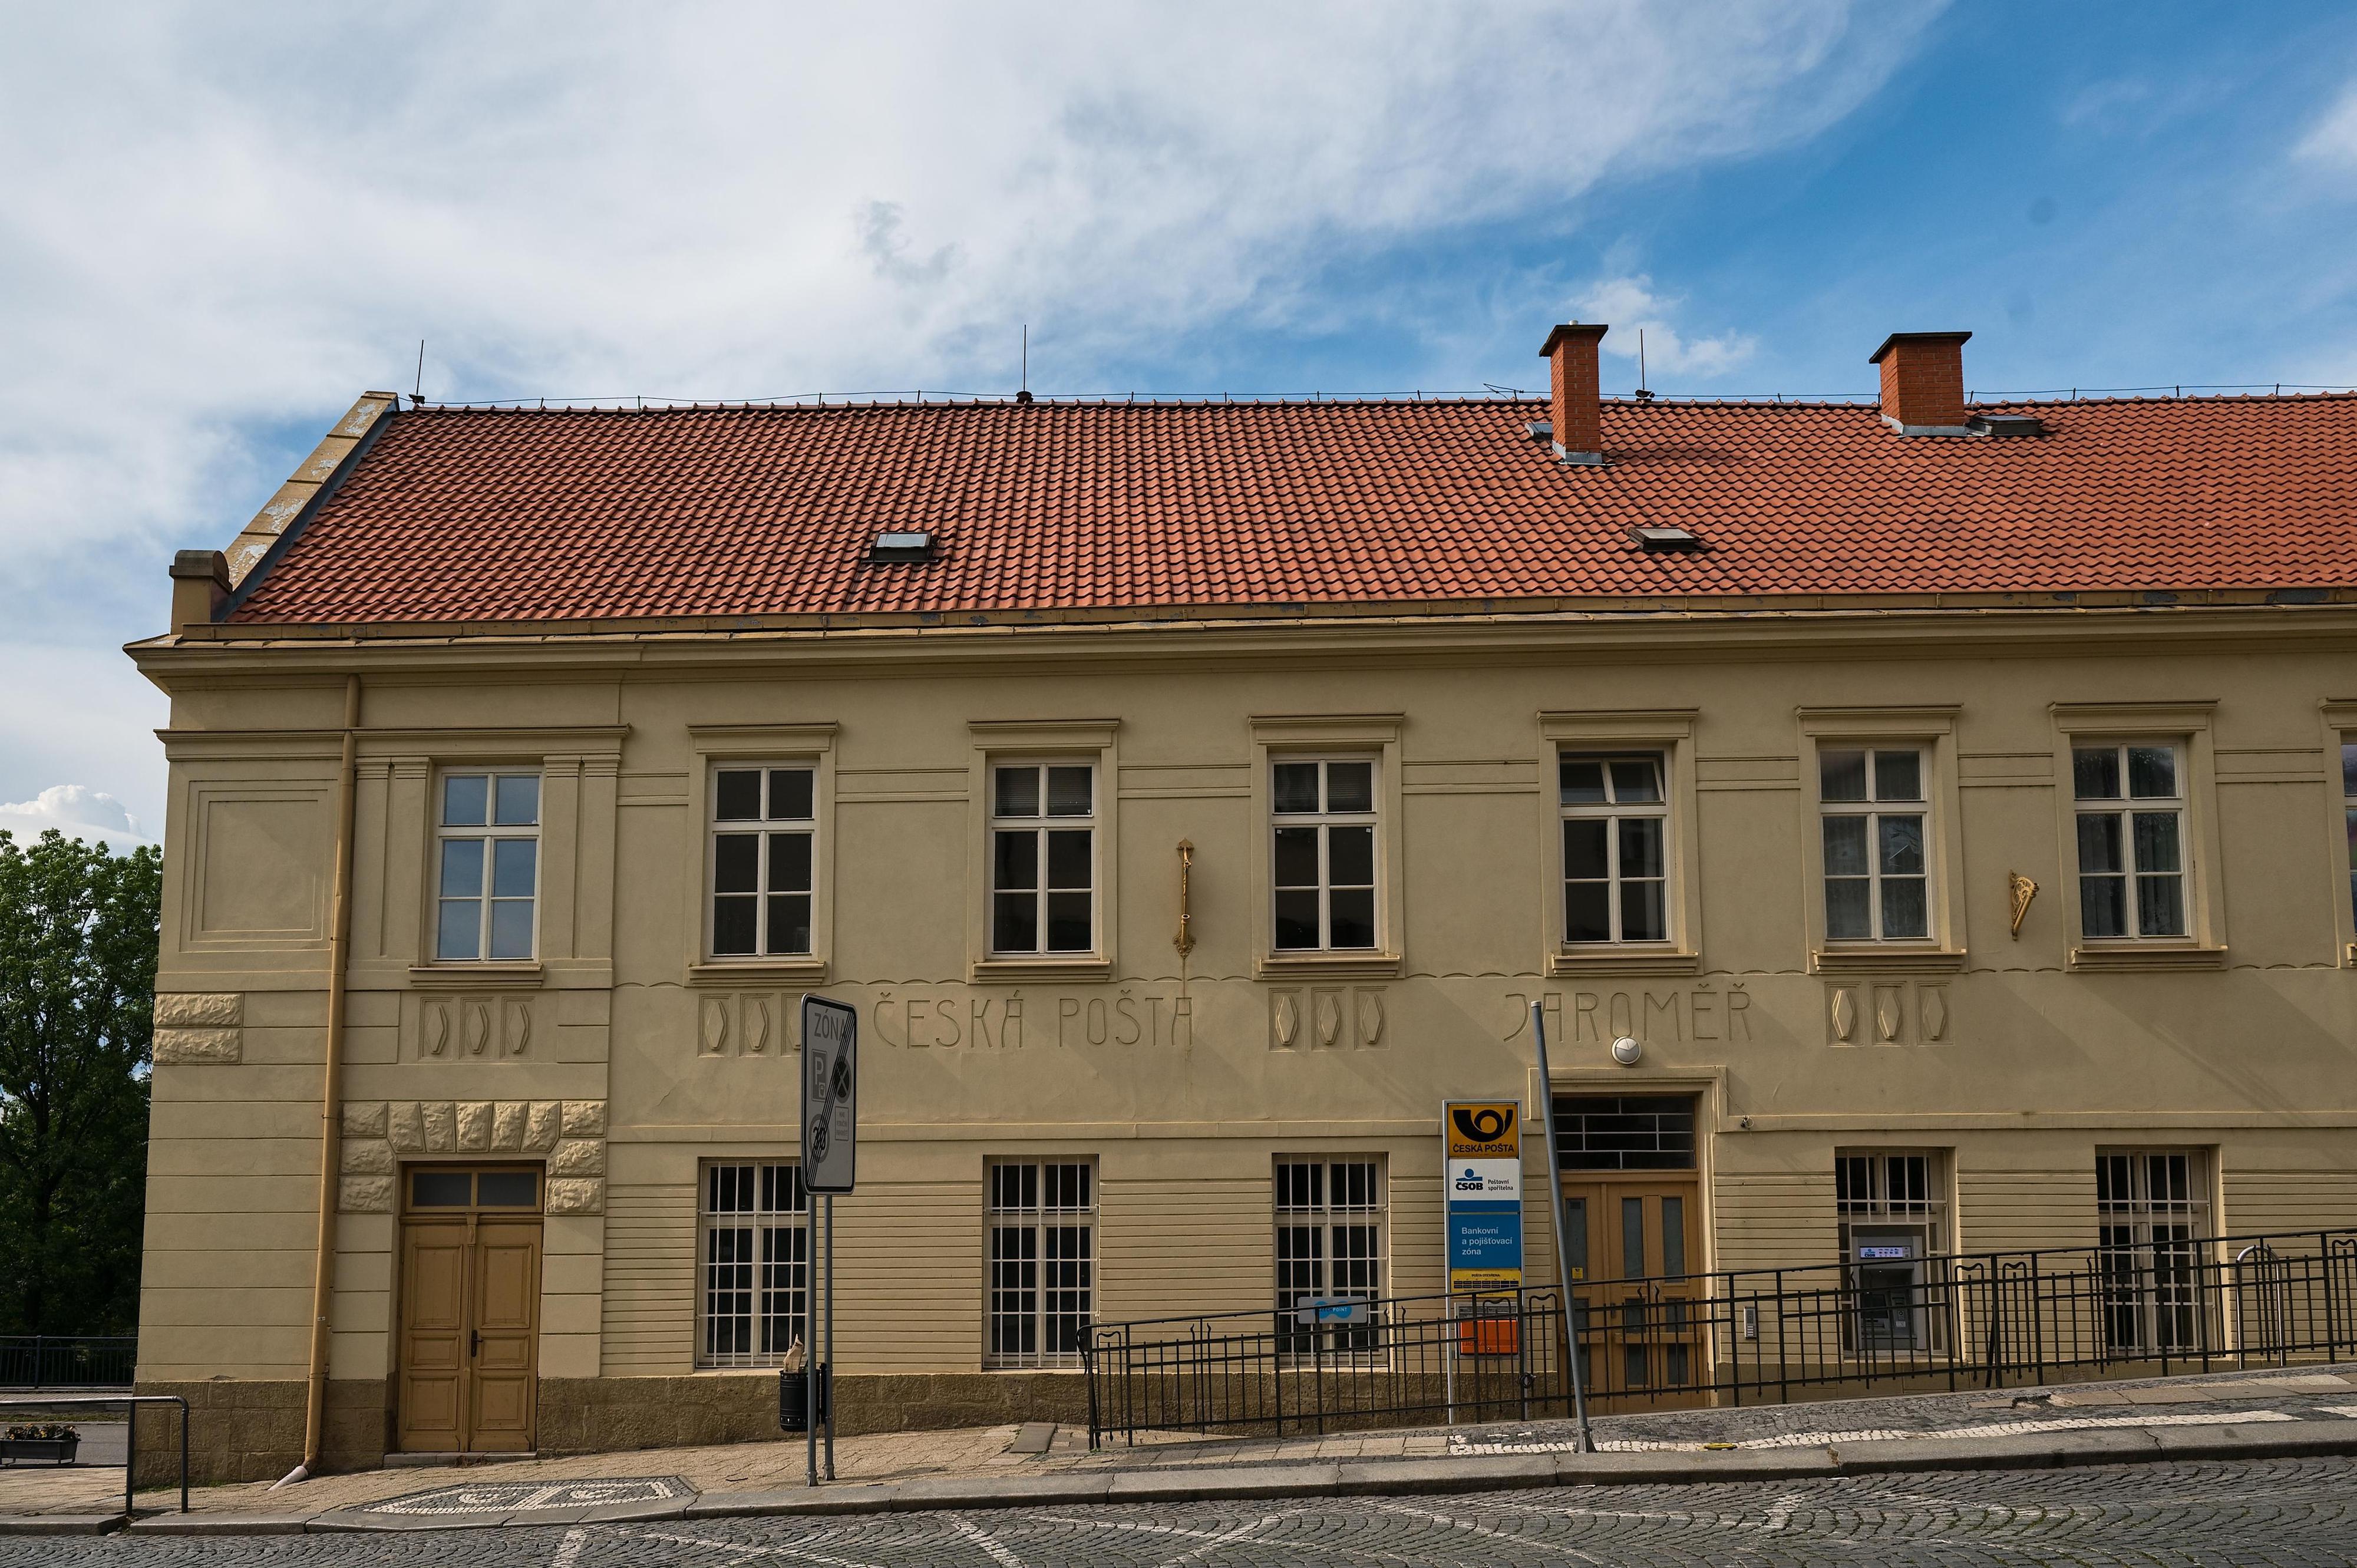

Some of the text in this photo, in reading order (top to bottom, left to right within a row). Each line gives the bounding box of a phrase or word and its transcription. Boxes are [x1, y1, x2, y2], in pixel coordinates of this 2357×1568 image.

[874, 989, 1193, 1048] ČESKÁ POŠTA
[1503, 983, 1752, 1042] JAROMĚŘ
[814, 1009, 847, 1042] ZÓNA
[1453, 1143, 1514, 1153] ČESKÁ POŠTA
[1455, 1181, 1483, 1190] ČSOB
[1469, 1237, 1513, 1246] pojišťovací
